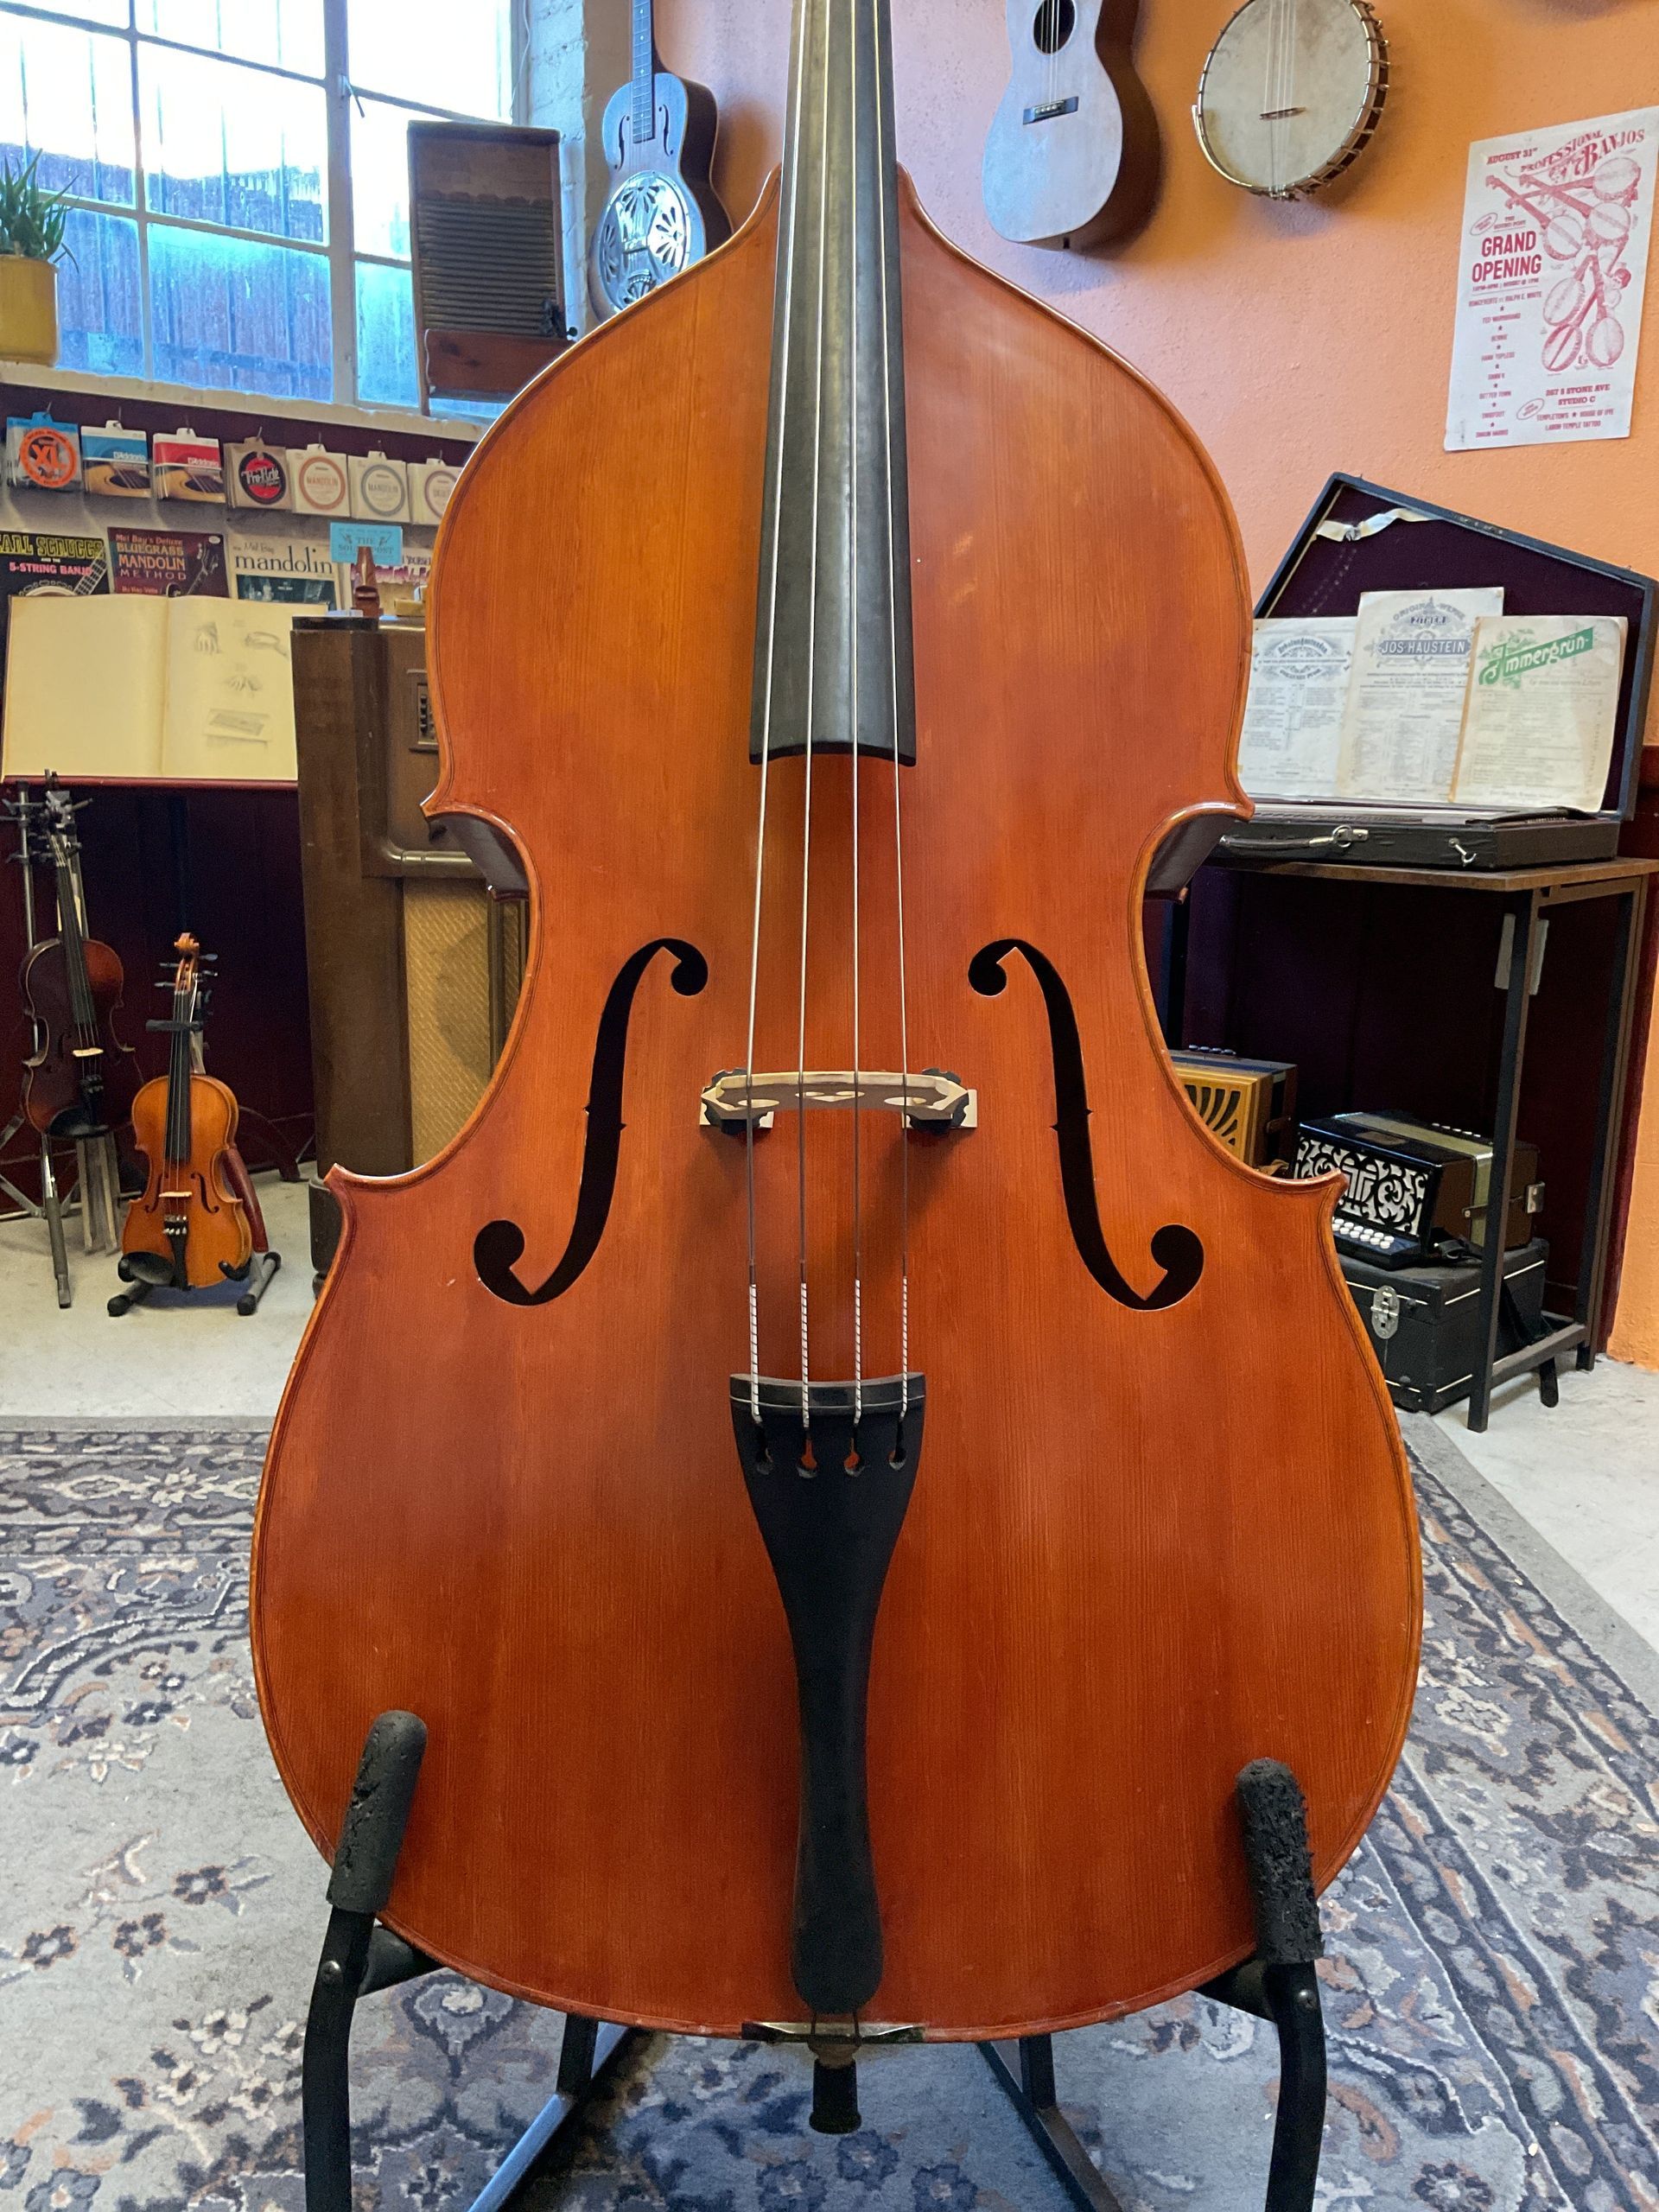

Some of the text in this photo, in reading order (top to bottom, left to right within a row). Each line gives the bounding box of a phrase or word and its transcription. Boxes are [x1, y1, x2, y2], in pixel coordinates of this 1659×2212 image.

[1486, 150, 1521, 165] AUGUST
[1482, 231, 1536, 257] GRAND
[1472, 254, 1541, 283] OPENING
[1594, 384, 1611, 392] AVE
[31, 444, 66, 469] XL
[0, 534, 34, 556] ARL
[117, 543, 184, 556] BLUEGRASS
[118, 554, 186, 570] MANDOLIN
[235, 545, 333, 574] mandolin
[10, 562, 93, 576] 5-STRING BANJO
[120, 569, 187, 581] METHOD
[1408, 641, 1465, 653] HAUSTEIN
